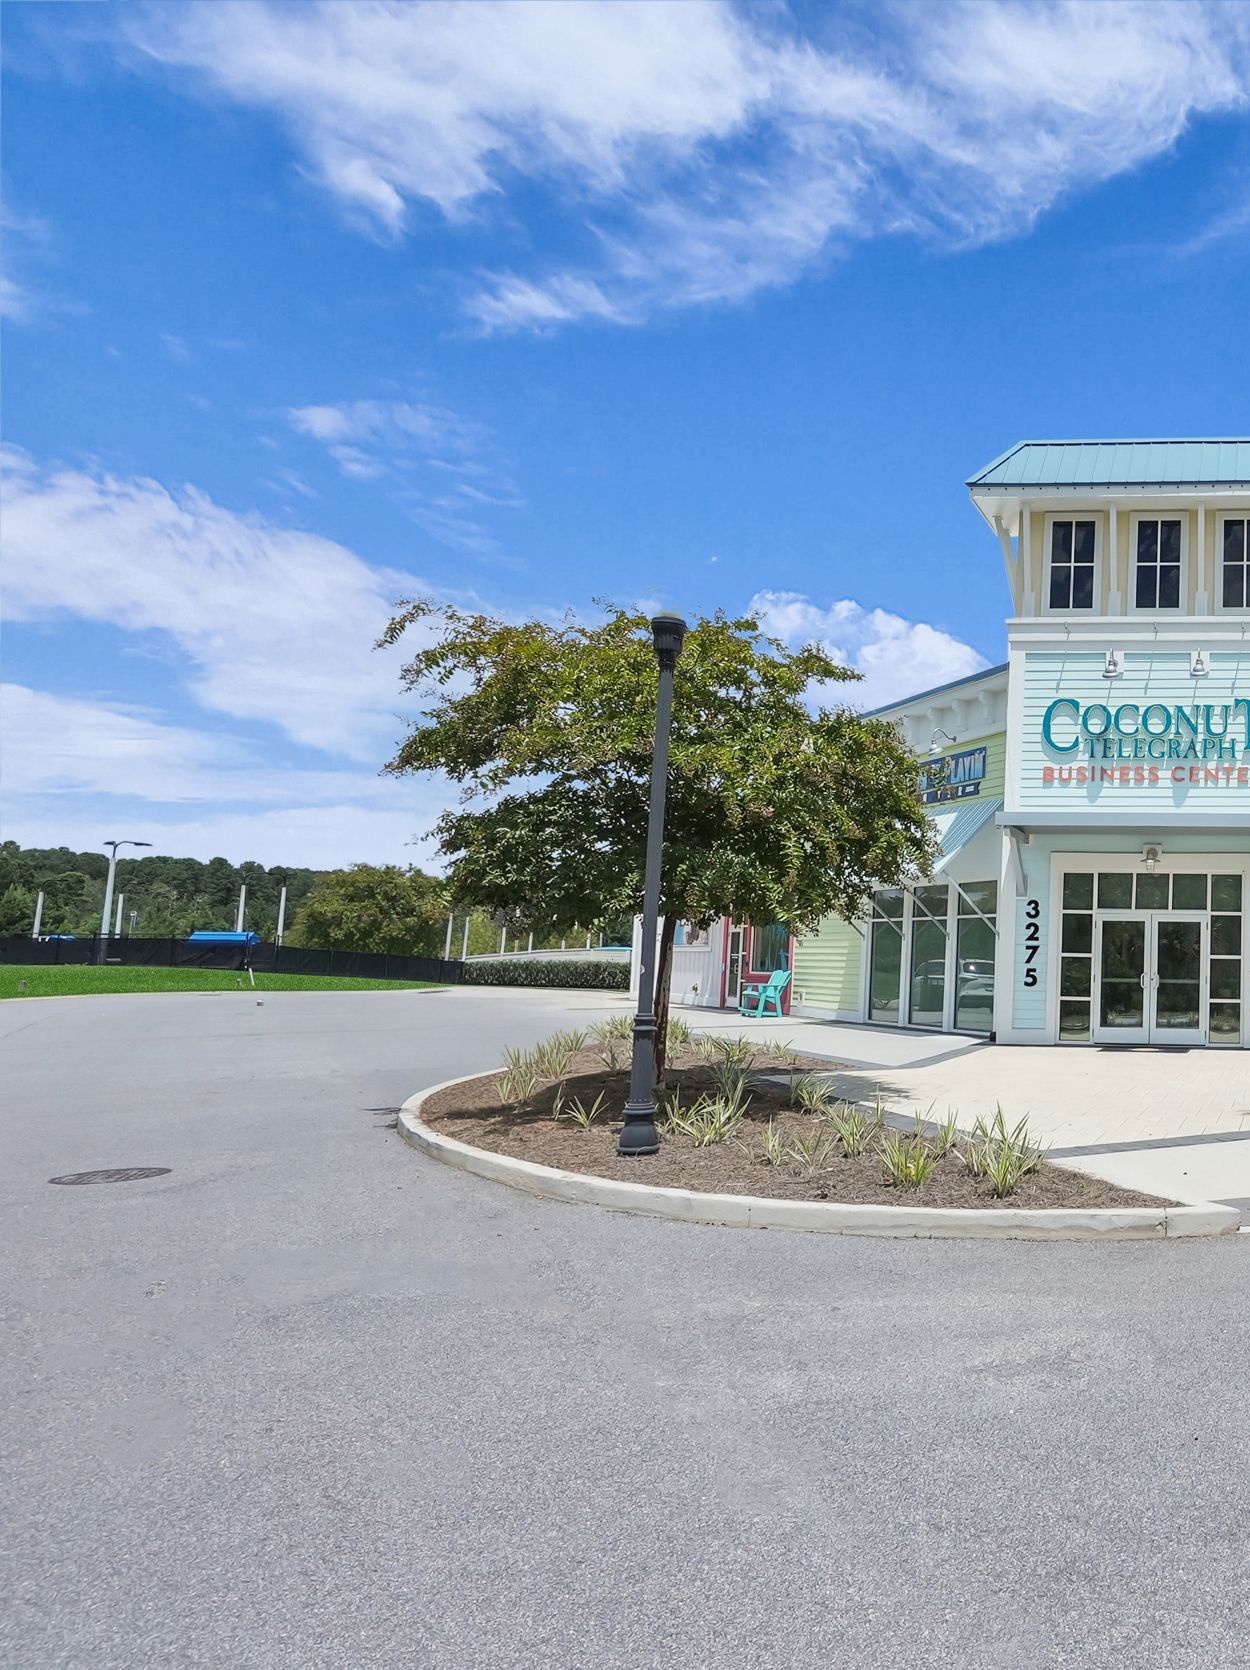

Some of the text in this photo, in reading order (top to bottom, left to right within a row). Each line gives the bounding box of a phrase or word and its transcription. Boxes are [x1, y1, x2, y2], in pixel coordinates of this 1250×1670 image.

[1085, 738, 1237, 759] TELEGRAPH
[1043, 765, 1160, 784] BUSINESS
[1023, 899, 1040, 987] 3275
